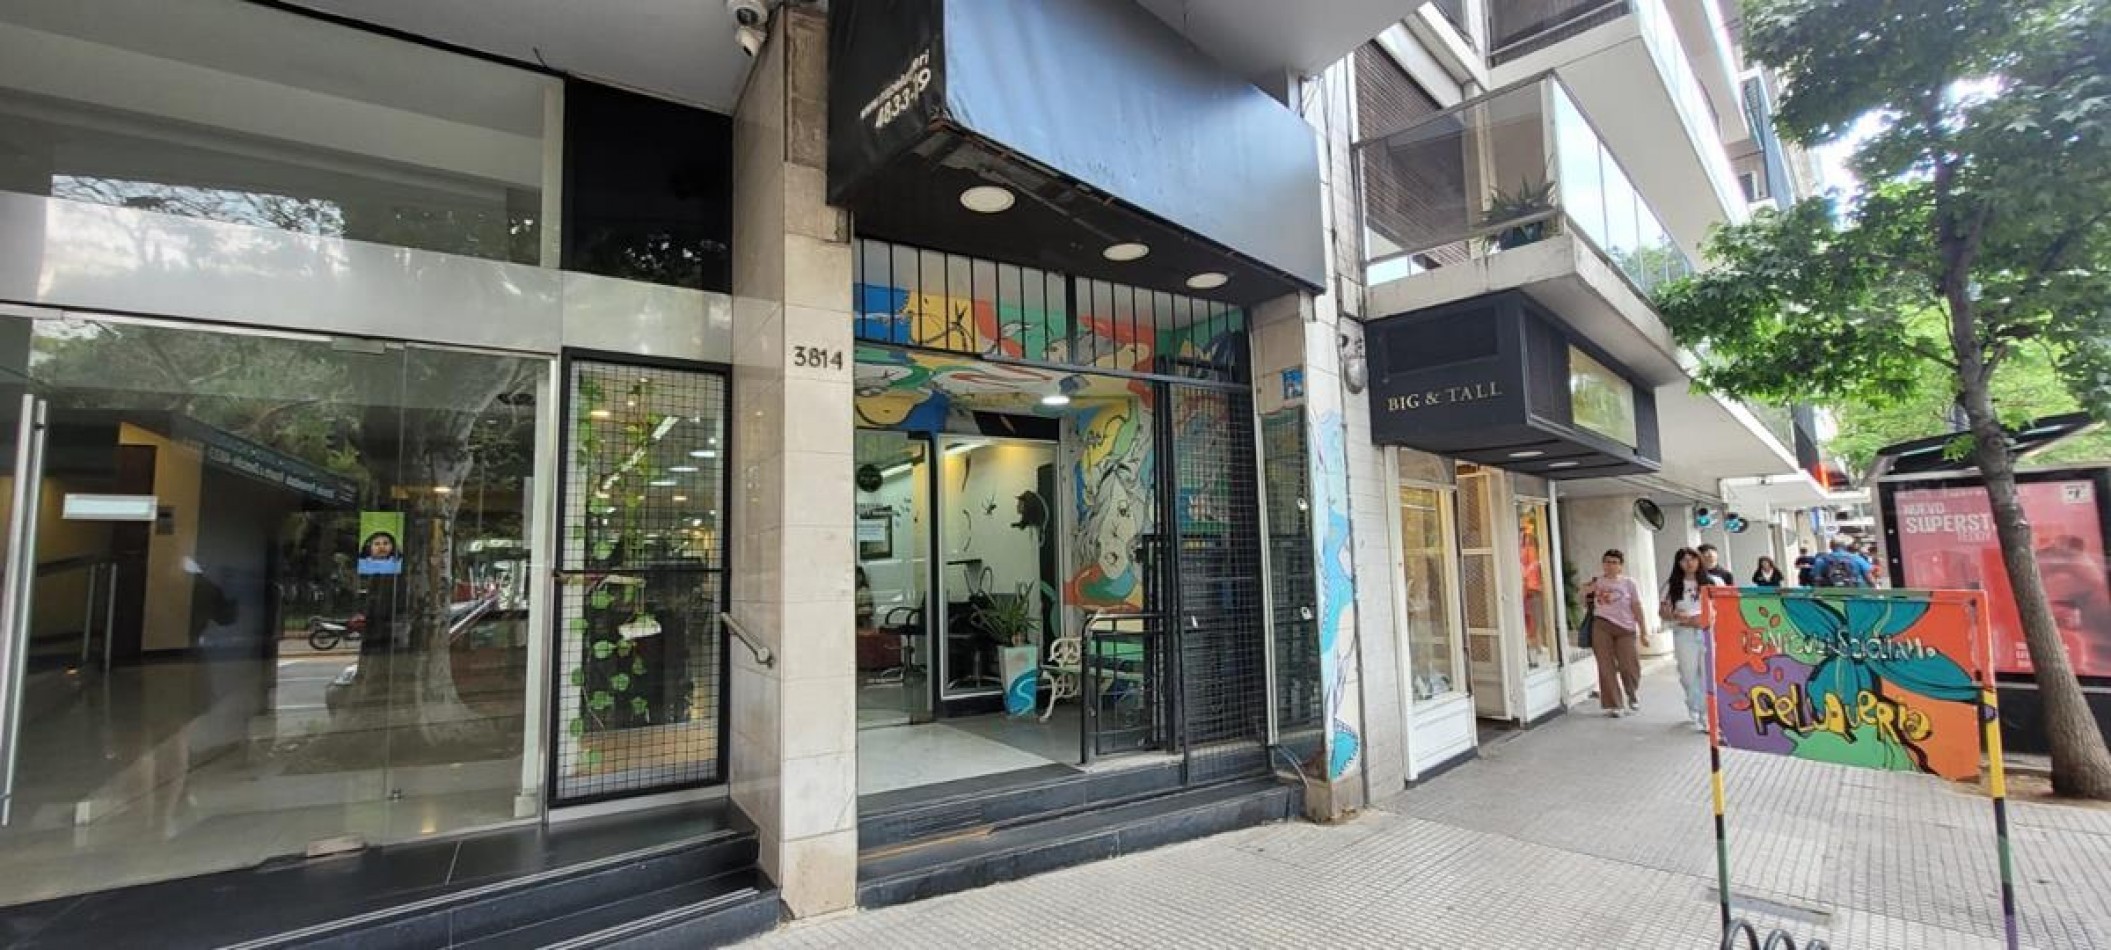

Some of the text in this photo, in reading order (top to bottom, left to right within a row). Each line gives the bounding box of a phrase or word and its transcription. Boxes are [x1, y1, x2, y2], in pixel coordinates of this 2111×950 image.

[794, 346, 843, 370] 3814
[1388, 381, 1503, 412] BIG & TALL
[1906, 512, 1997, 534] SUPERST
